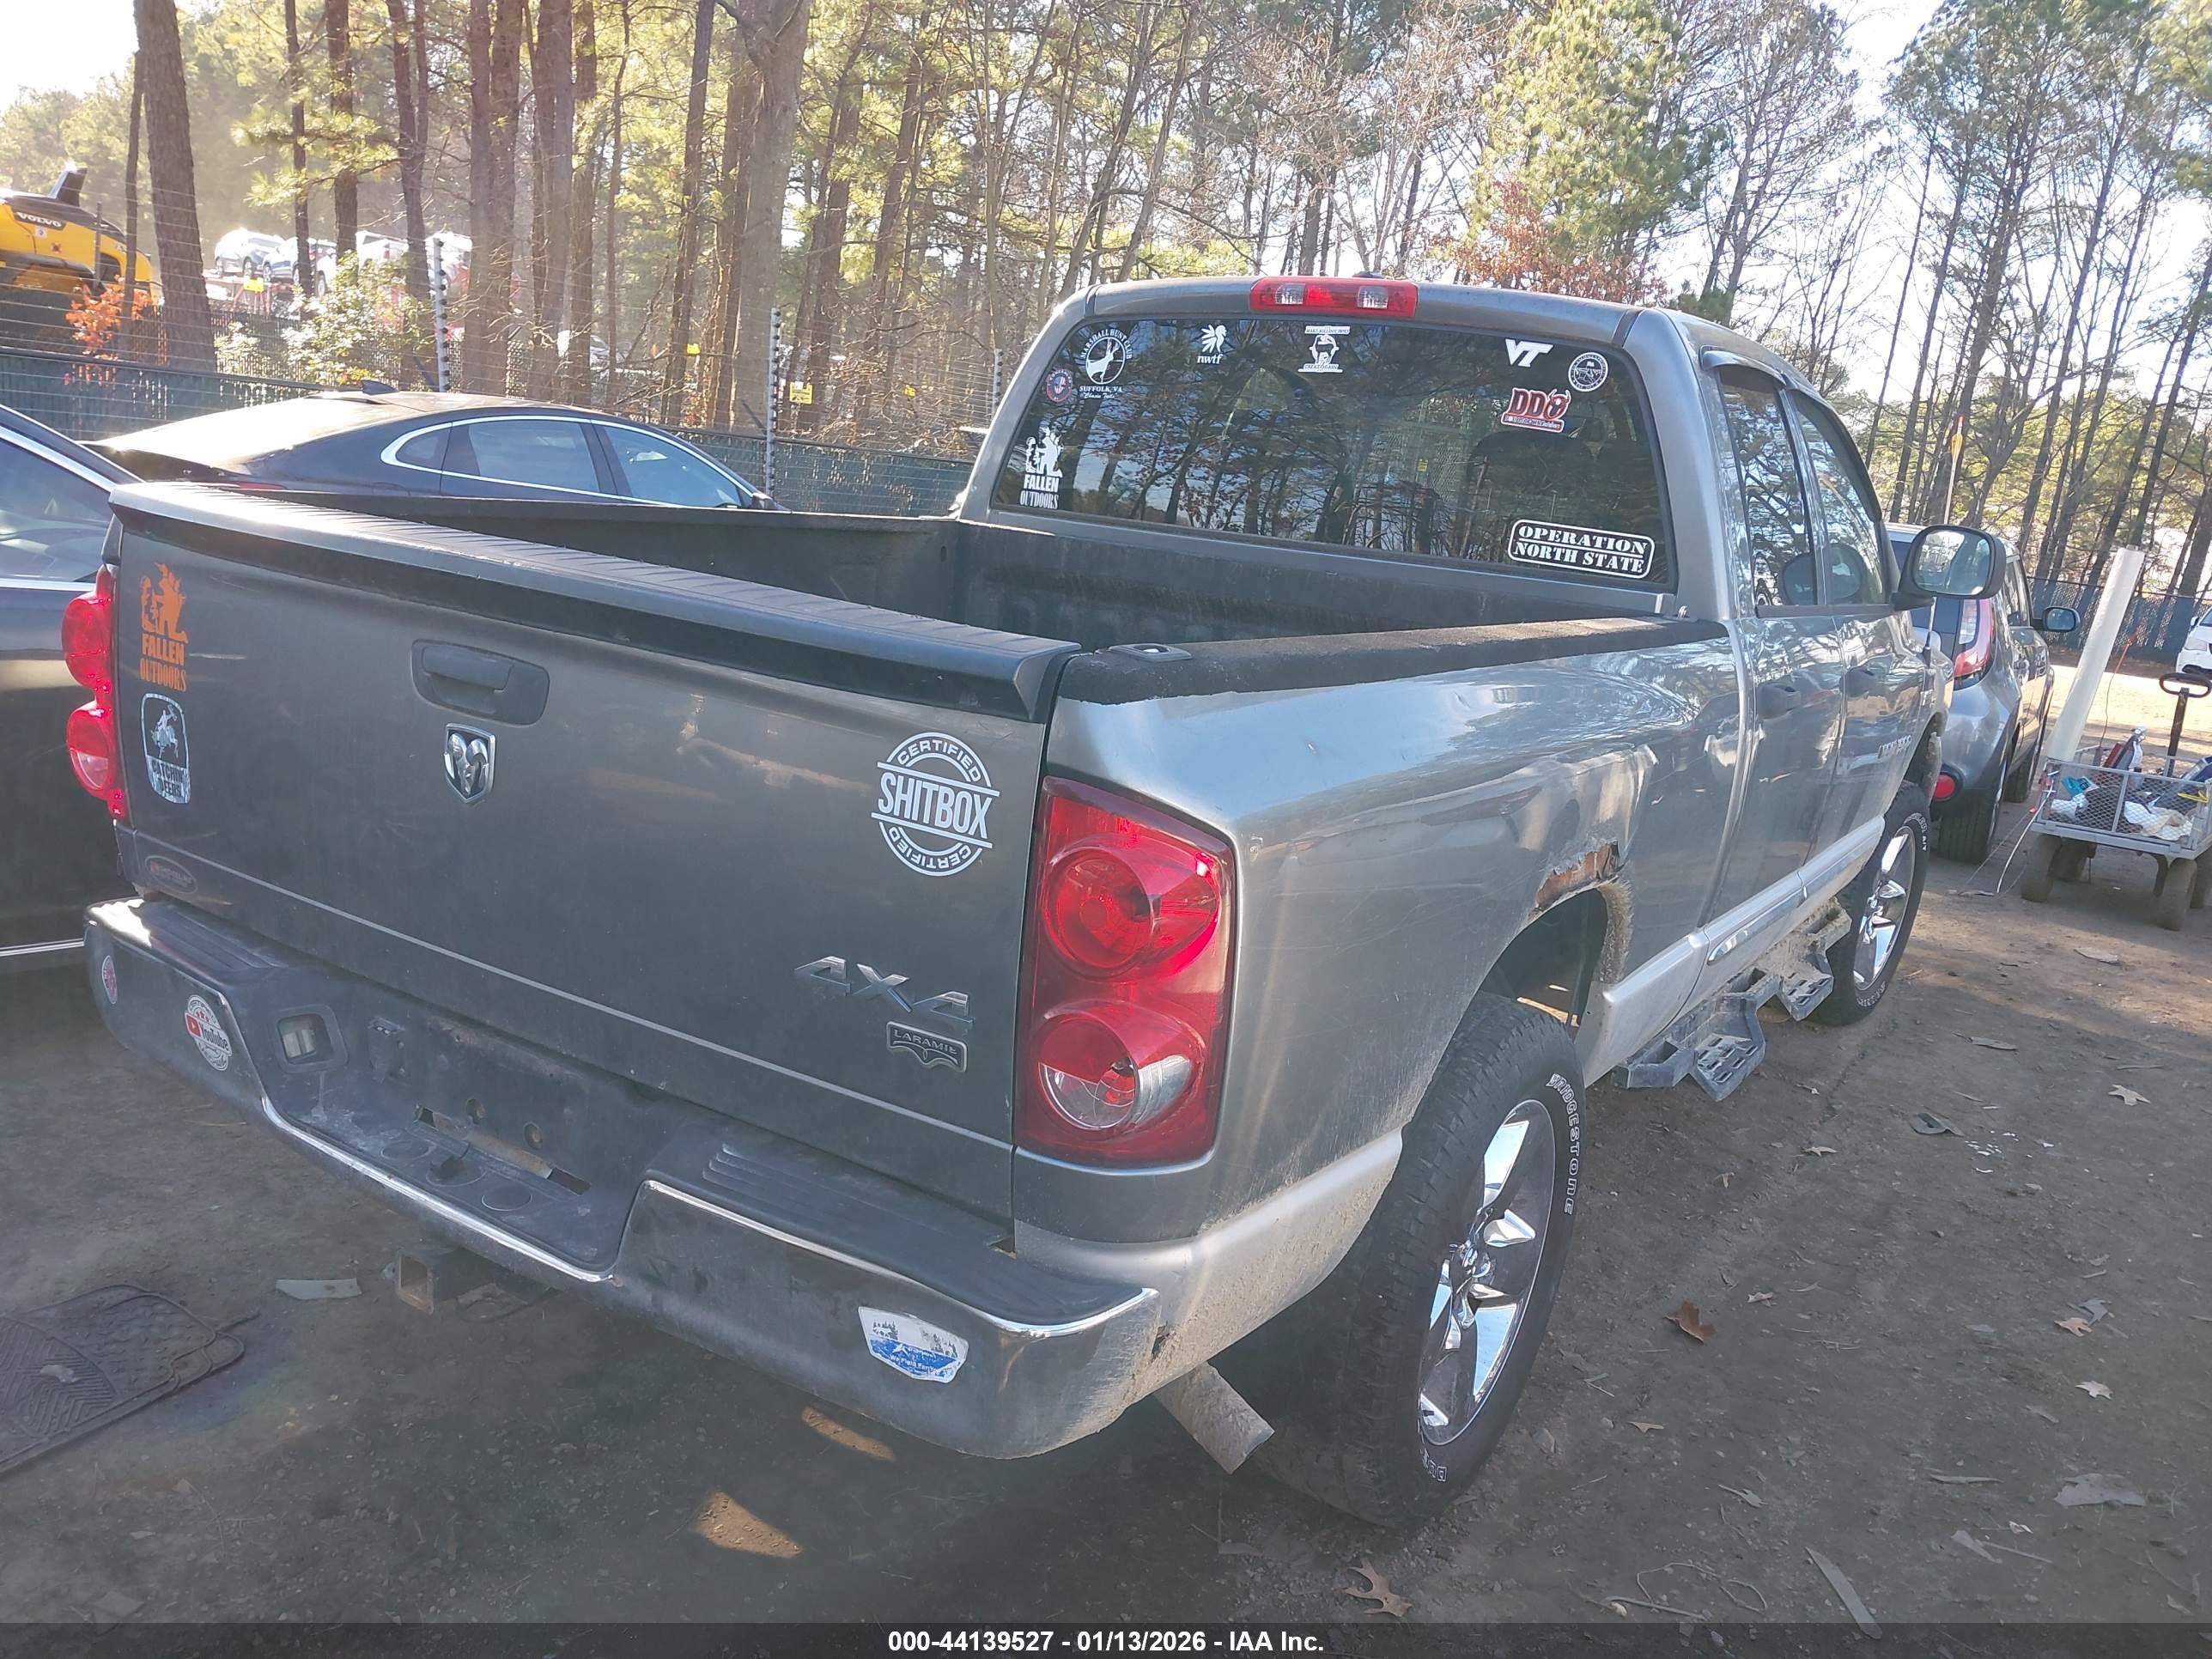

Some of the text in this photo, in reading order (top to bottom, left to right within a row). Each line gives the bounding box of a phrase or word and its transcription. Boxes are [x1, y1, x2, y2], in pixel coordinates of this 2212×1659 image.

[16, 212, 62, 228] VOLVO
[1080, 328, 1133, 360] MARSHALL HUNT CLUB
[1196, 353, 1224, 365] nwtf
[1505, 338, 1553, 368] VT
[1024, 473, 1060, 493] FALLEN
[1020, 490, 1059, 509] OUTDOORS
[1518, 526, 1648, 554] OPERATION
[1513, 542, 1644, 573] NORTH STATE
[143, 634, 185, 665] FALLEN
[139, 658, 186, 692] OUTDOORS
[897, 739, 981, 782] CERTIFIED
[158, 778, 183, 797] DEERS
[878, 772, 993, 839] SHITBOX
[888, 826, 972, 869] CERTIFIED
[199, 1022, 230, 1052] YouTube
[894, 1029, 958, 1055] LARAMIE
[1546, 1073, 1581, 1216] BRIDGESTONE
